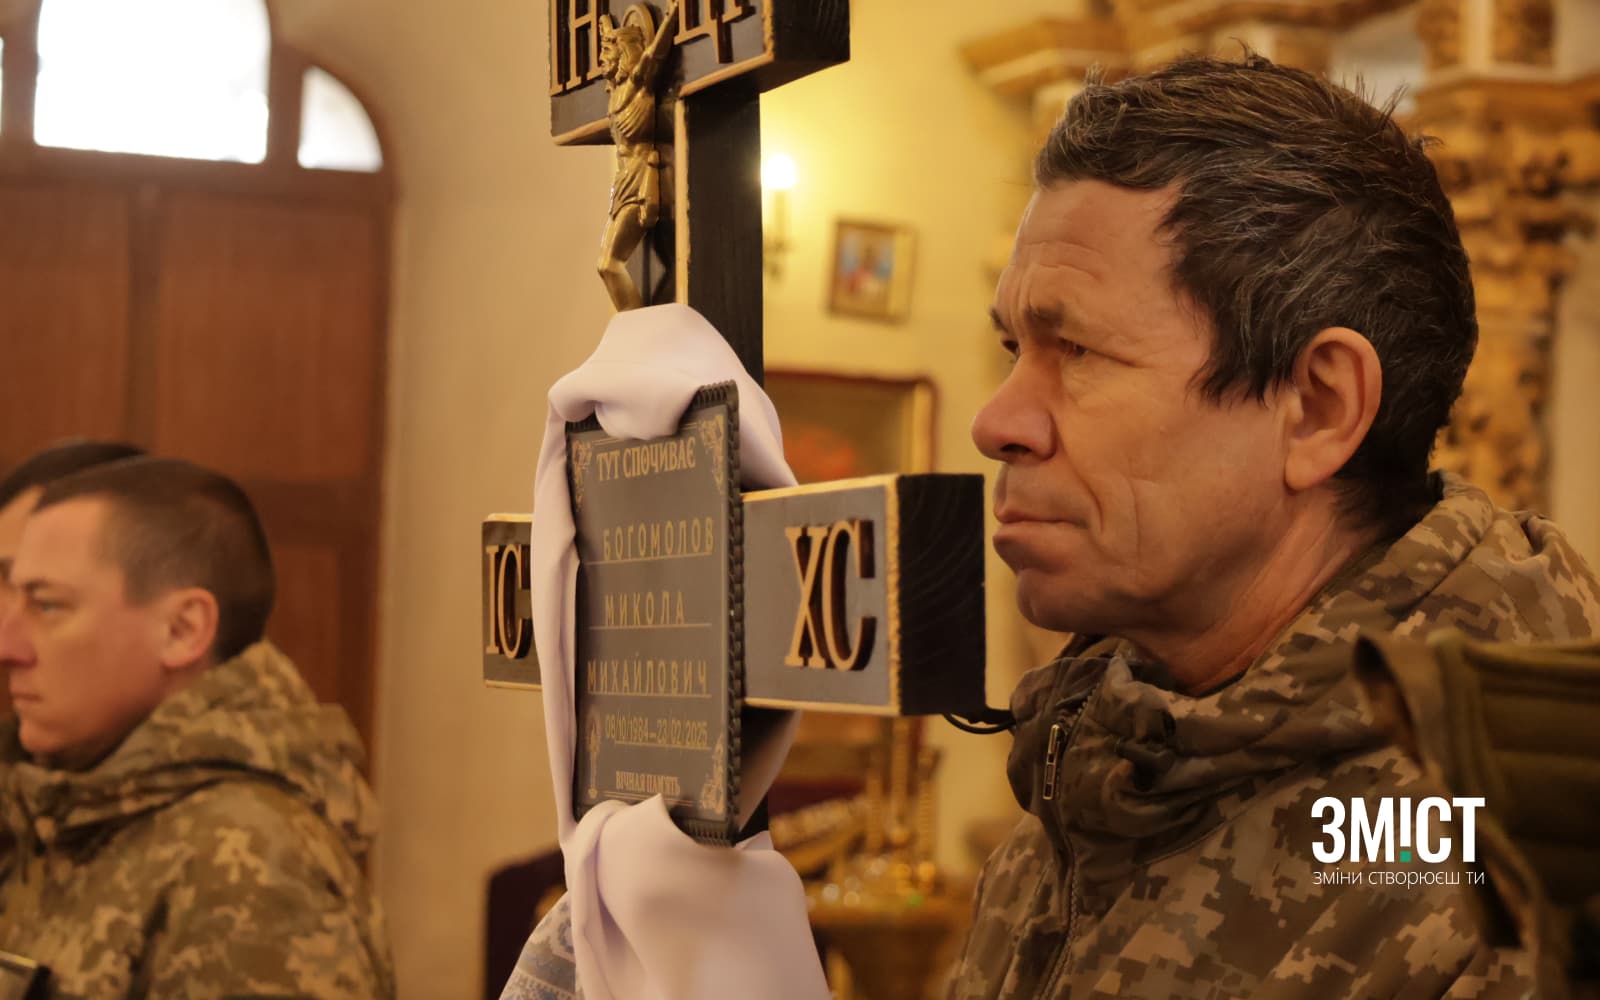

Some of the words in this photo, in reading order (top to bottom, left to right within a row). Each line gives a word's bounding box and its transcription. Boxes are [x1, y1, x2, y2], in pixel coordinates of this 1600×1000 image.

[596, 450, 621, 481] ТУТ
[622, 436, 697, 479] СПОЧИВАЄ
[603, 516, 714, 561] БОГОМОЛОВ
[604, 590, 685, 627] МИКОЛА
[587, 652, 707, 696] МИХАЙЛОВИЧ
